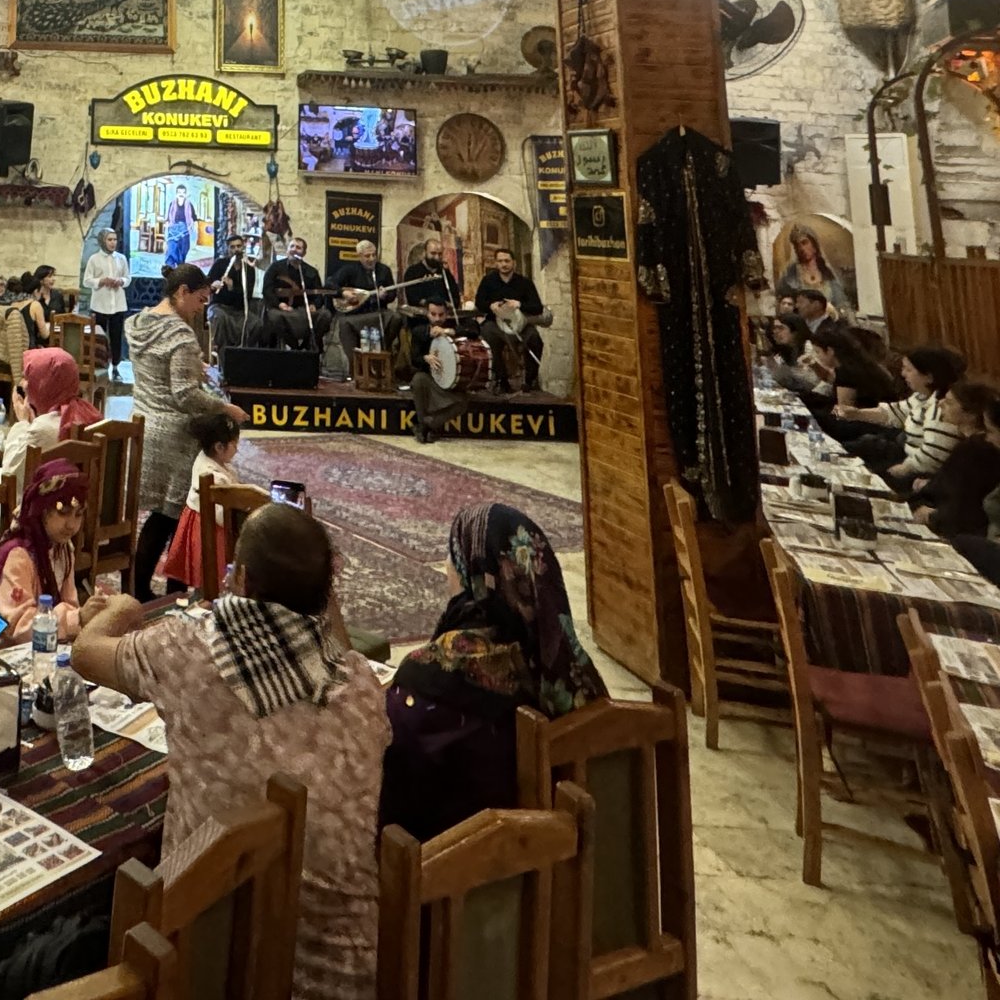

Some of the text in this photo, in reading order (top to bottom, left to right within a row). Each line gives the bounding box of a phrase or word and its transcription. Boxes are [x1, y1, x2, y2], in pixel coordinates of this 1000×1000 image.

[123, 78, 249, 119] BUZHANI
[225, 133, 262, 141] RESTAURANT
[538, 150, 565, 163] BUZH
[538, 166, 566, 174] KONU
[332, 207, 375, 222] BUZHANI
[252, 403, 556, 437] BUZHANI KNUKEVİ
